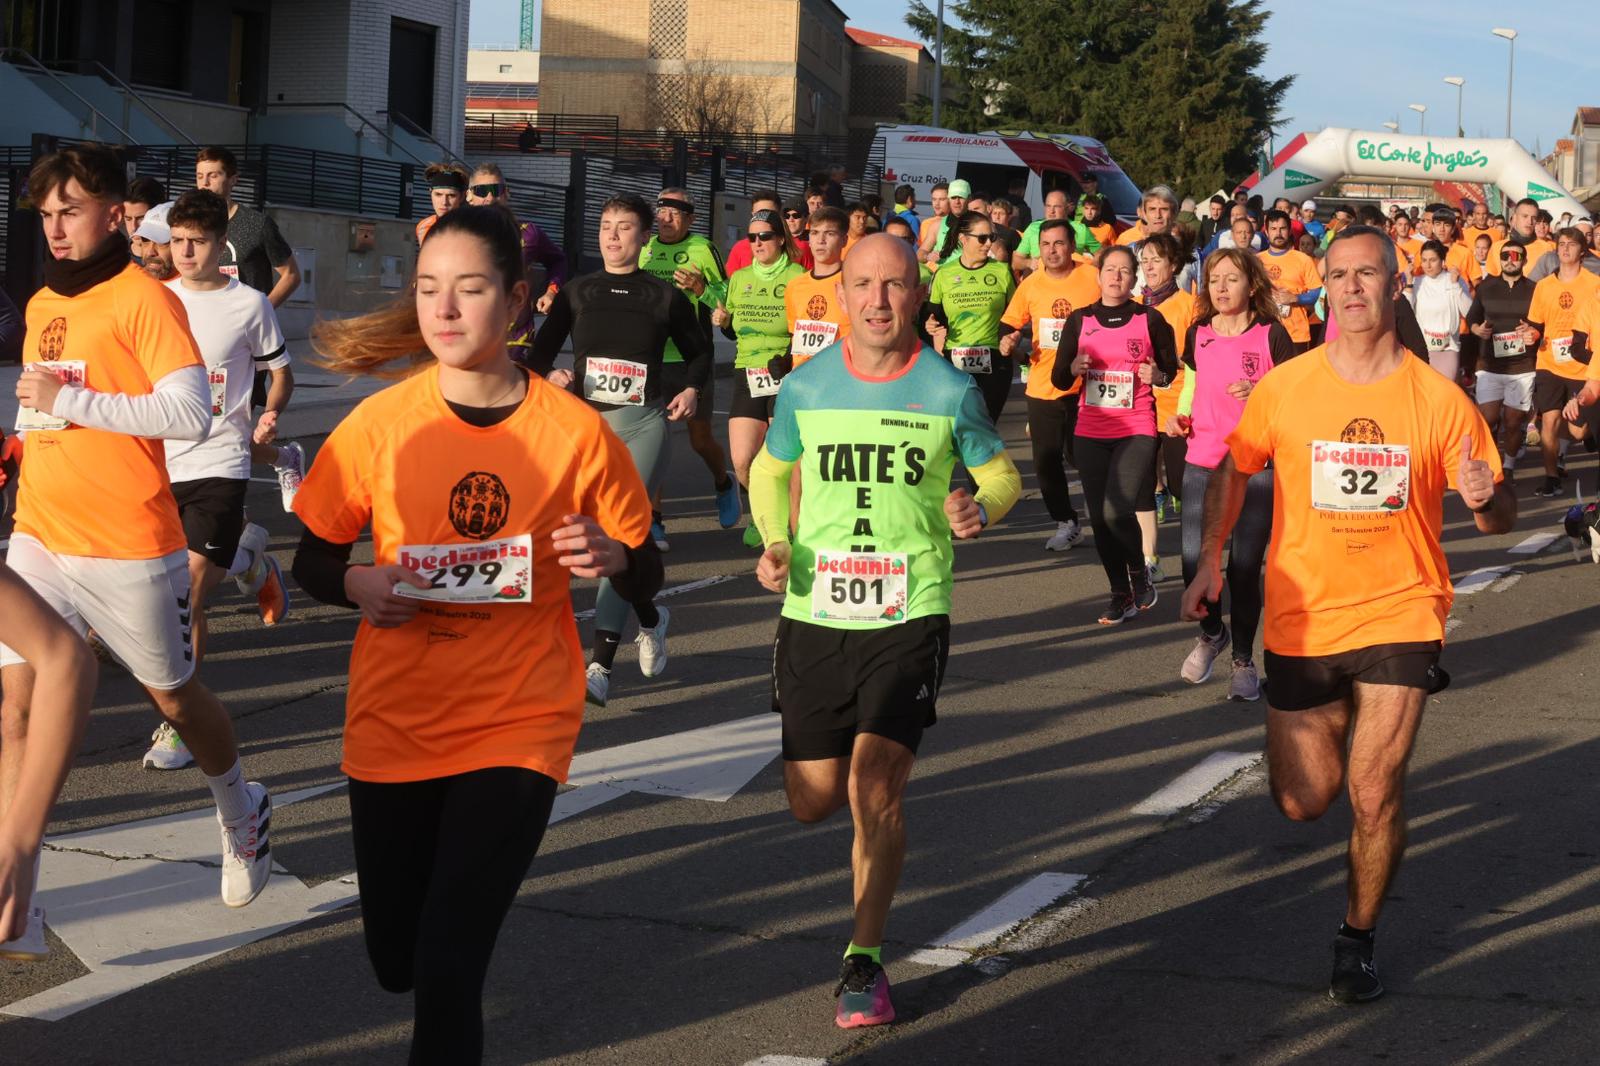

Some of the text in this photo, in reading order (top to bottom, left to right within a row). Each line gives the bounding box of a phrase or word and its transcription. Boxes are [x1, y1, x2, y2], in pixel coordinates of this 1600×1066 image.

[941, 136, 999, 148] AMBULANCIA
[1357, 139, 1488, 173] El Corte Inglés
[900, 173, 948, 185] Cruz Roja
[802, 332, 825, 348] 109
[1431, 338, 1443, 347] 68
[1503, 341, 1517, 351] 64
[960, 356, 984, 368] 124
[595, 374, 633, 394] 209
[1087, 370, 1133, 384] bedunia
[1098, 383, 1117, 399] 95
[880, 418, 909, 427] RUNNING
[915, 422, 929, 431] BIKE
[1314, 445, 1408, 468] bedunia
[1340, 468, 1379, 496] 32
[1345, 526, 1373, 534] Silvestre
[1373, 525, 1390, 533] 2023
[401, 544, 529, 573] bedunia
[817, 555, 906, 577] bedunia
[426, 561, 503, 590] 299
[830, 577, 884, 605] 501
